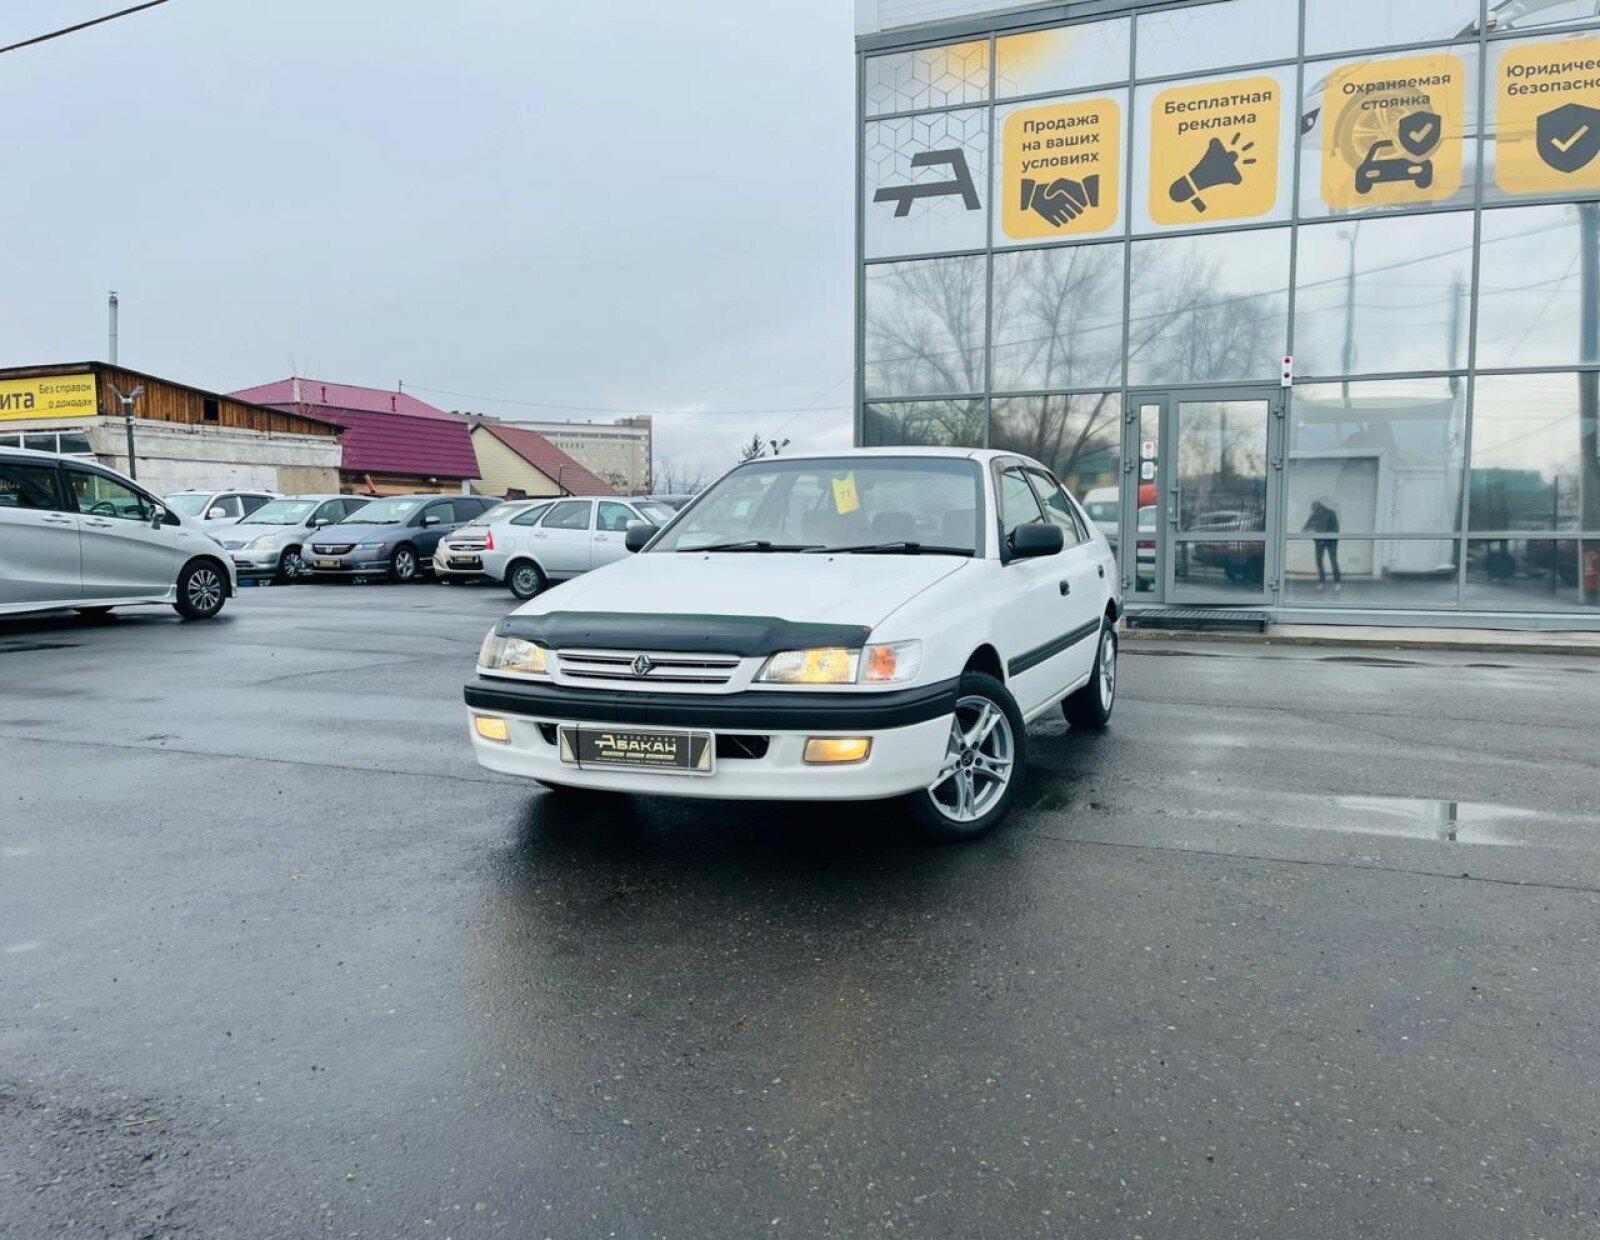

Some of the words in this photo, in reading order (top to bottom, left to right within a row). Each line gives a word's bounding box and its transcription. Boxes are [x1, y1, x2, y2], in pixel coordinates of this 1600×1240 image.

[1343, 75, 1451, 95] Охраняемая
[1164, 89, 1273, 115] Бесплатная
[1361, 95, 1431, 111] стоянка
[1023, 113, 1100, 135] Продажа
[1178, 112, 1257, 135] реклама
[1021, 140, 1041, 151] на
[1046, 132, 1100, 149] ваших
[1021, 152, 1100, 173] условиях
